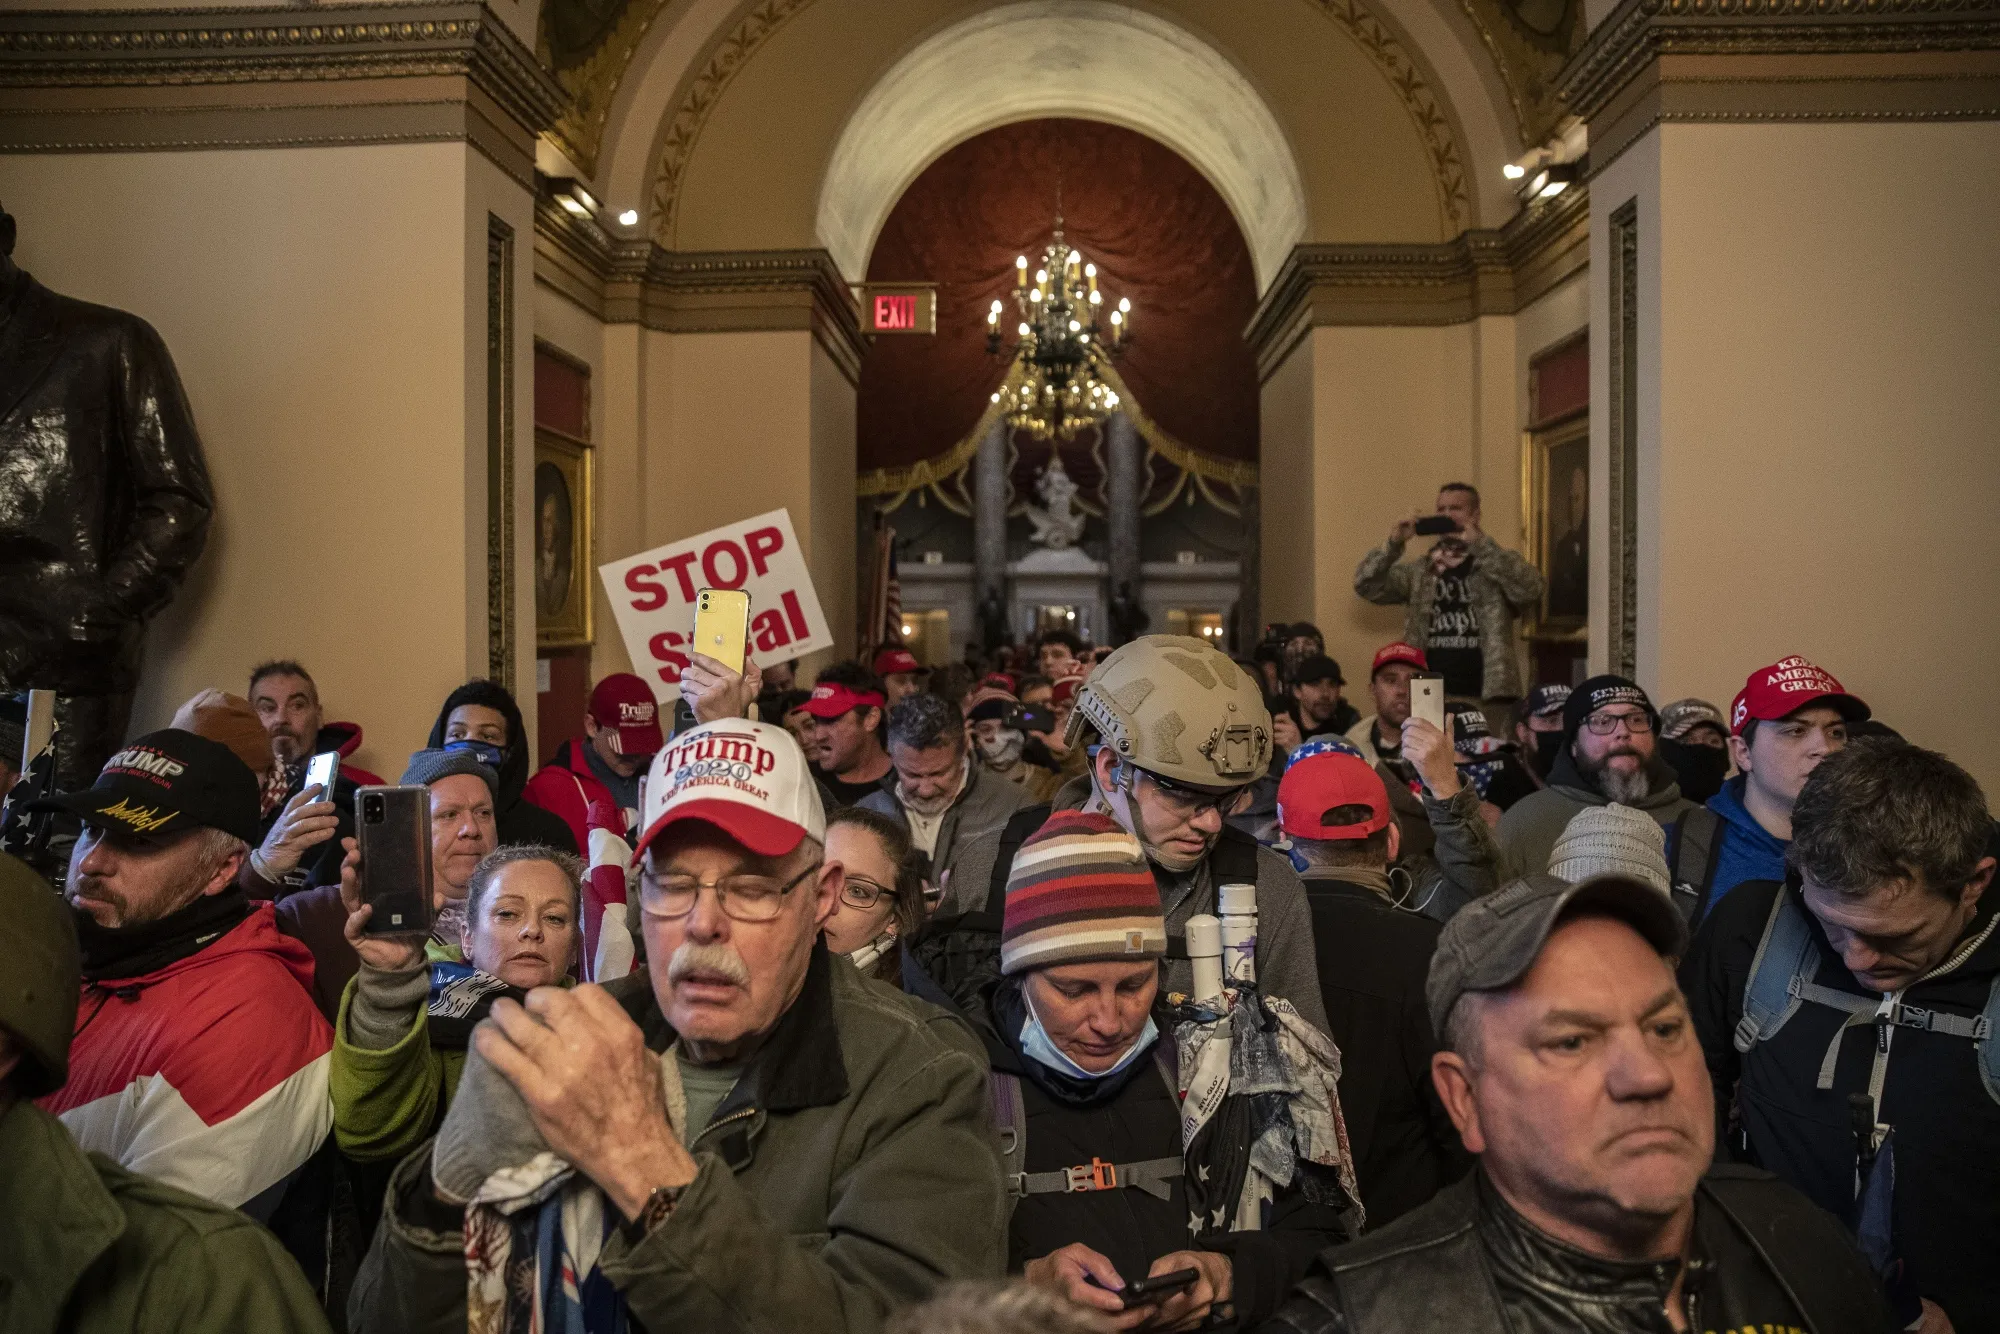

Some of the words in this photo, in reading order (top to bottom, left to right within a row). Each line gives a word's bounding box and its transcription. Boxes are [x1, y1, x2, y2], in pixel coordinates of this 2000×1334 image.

[875, 296, 918, 329] EXIT
[624, 526, 785, 612] STOP
[648, 589, 811, 684] Sal
[664, 738, 775, 777] Trump
[675, 758, 752, 785] 2020
[682, 775, 731, 790] AMERICA
[734, 779, 770, 802] GREAT
